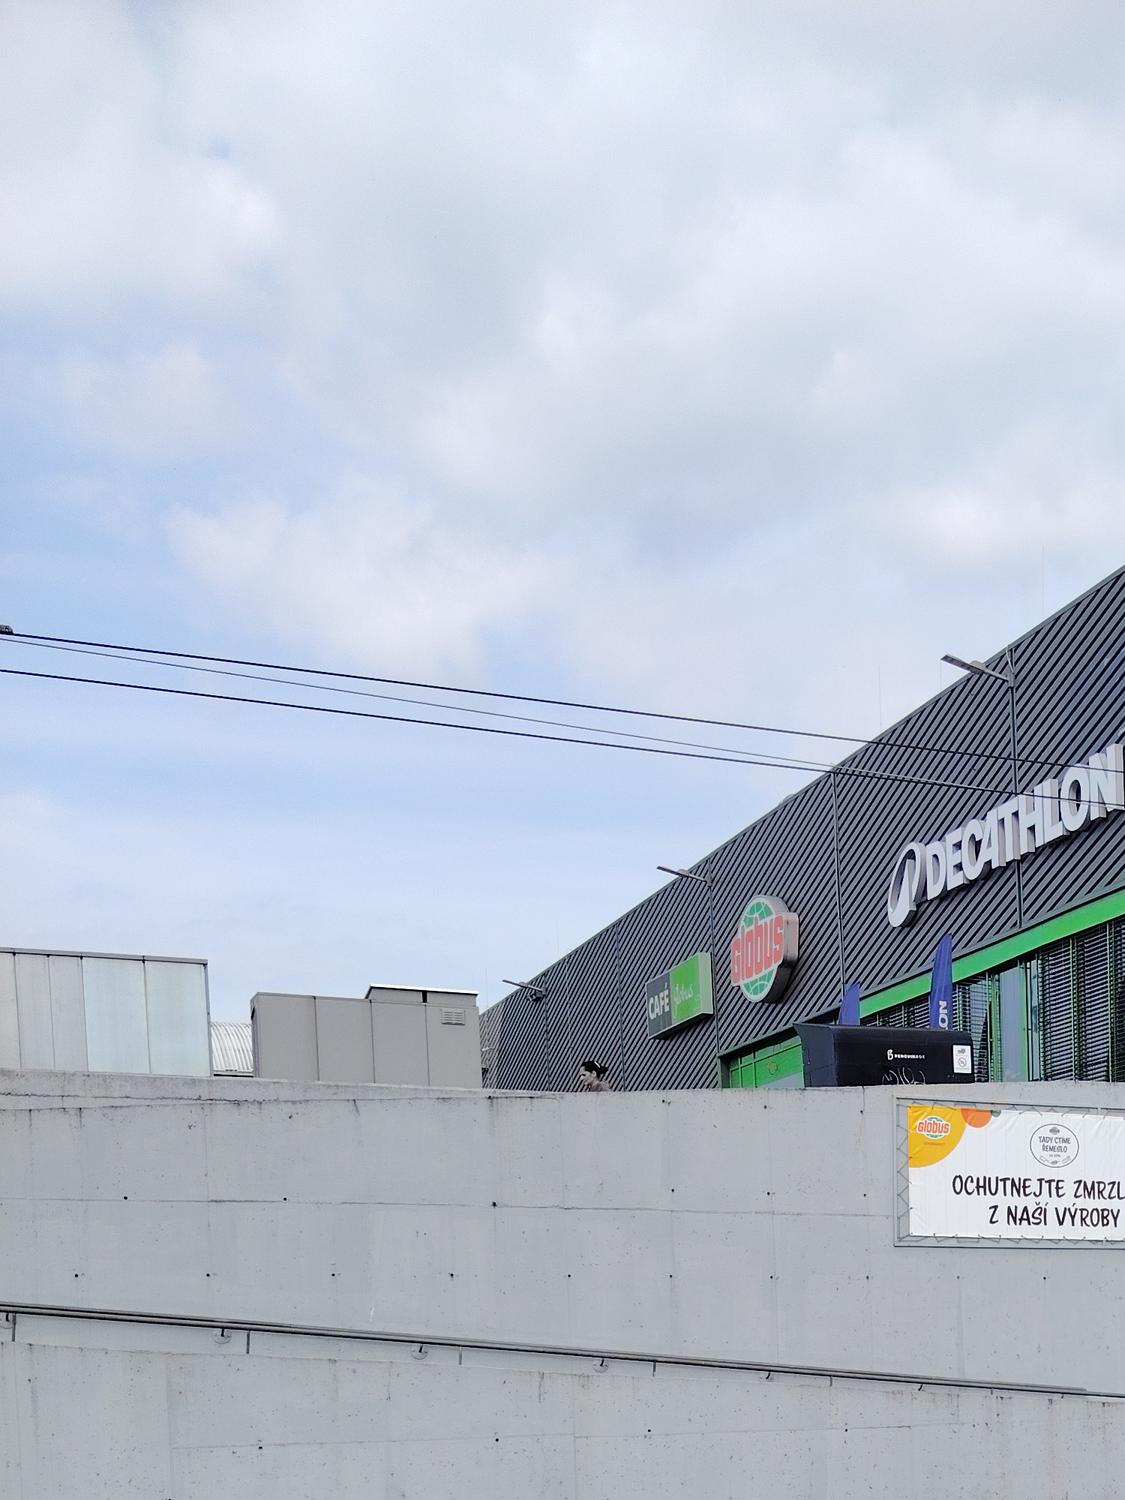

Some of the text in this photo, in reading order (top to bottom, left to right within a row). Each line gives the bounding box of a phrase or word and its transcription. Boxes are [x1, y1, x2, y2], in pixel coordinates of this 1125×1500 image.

[924, 743, 1125, 901] DECATHLON
[648, 982, 670, 1020] CAFÉ
[952, 1174, 1066, 1198] OCHUTNEJTE
[988, 1201, 1121, 1228] Z NAŠÍ VÝROBY
